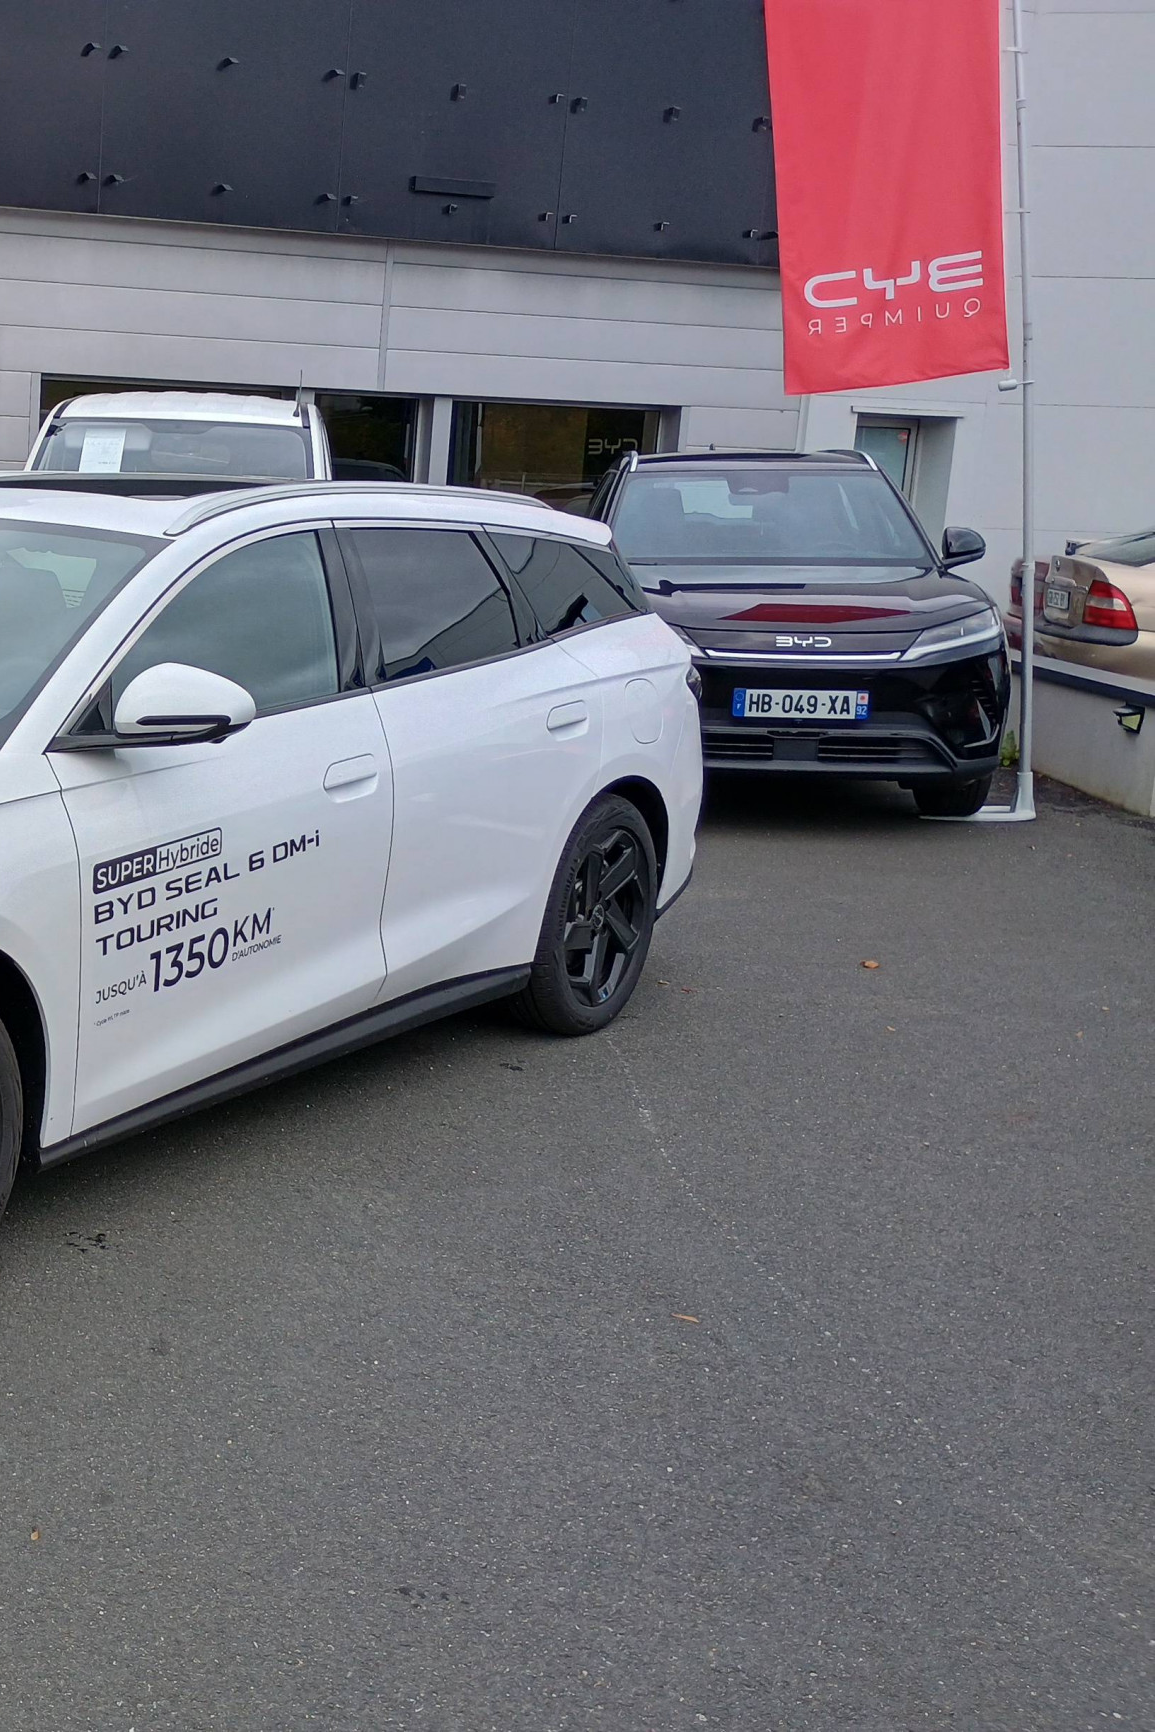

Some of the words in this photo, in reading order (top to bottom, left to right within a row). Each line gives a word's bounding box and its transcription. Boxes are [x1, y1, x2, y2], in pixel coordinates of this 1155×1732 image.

[775, 635, 832, 648] BYD
[748, 693, 851, 715] HB-049-XA
[856, 705, 867, 715] 92
[93, 886, 156, 925] BYD
[165, 862, 240, 901] SEAL
[248, 850, 265, 872] 6
[272, 829, 320, 864] DM-i
[96, 853, 155, 890] SUPER
[157, 835, 219, 870] Hybride
[95, 897, 218, 956] TOURING
[231, 934, 282, 962] D'AUTONOMIE
[95, 970, 147, 1005] JUSQU'À
[149, 927, 230, 993] 1350
